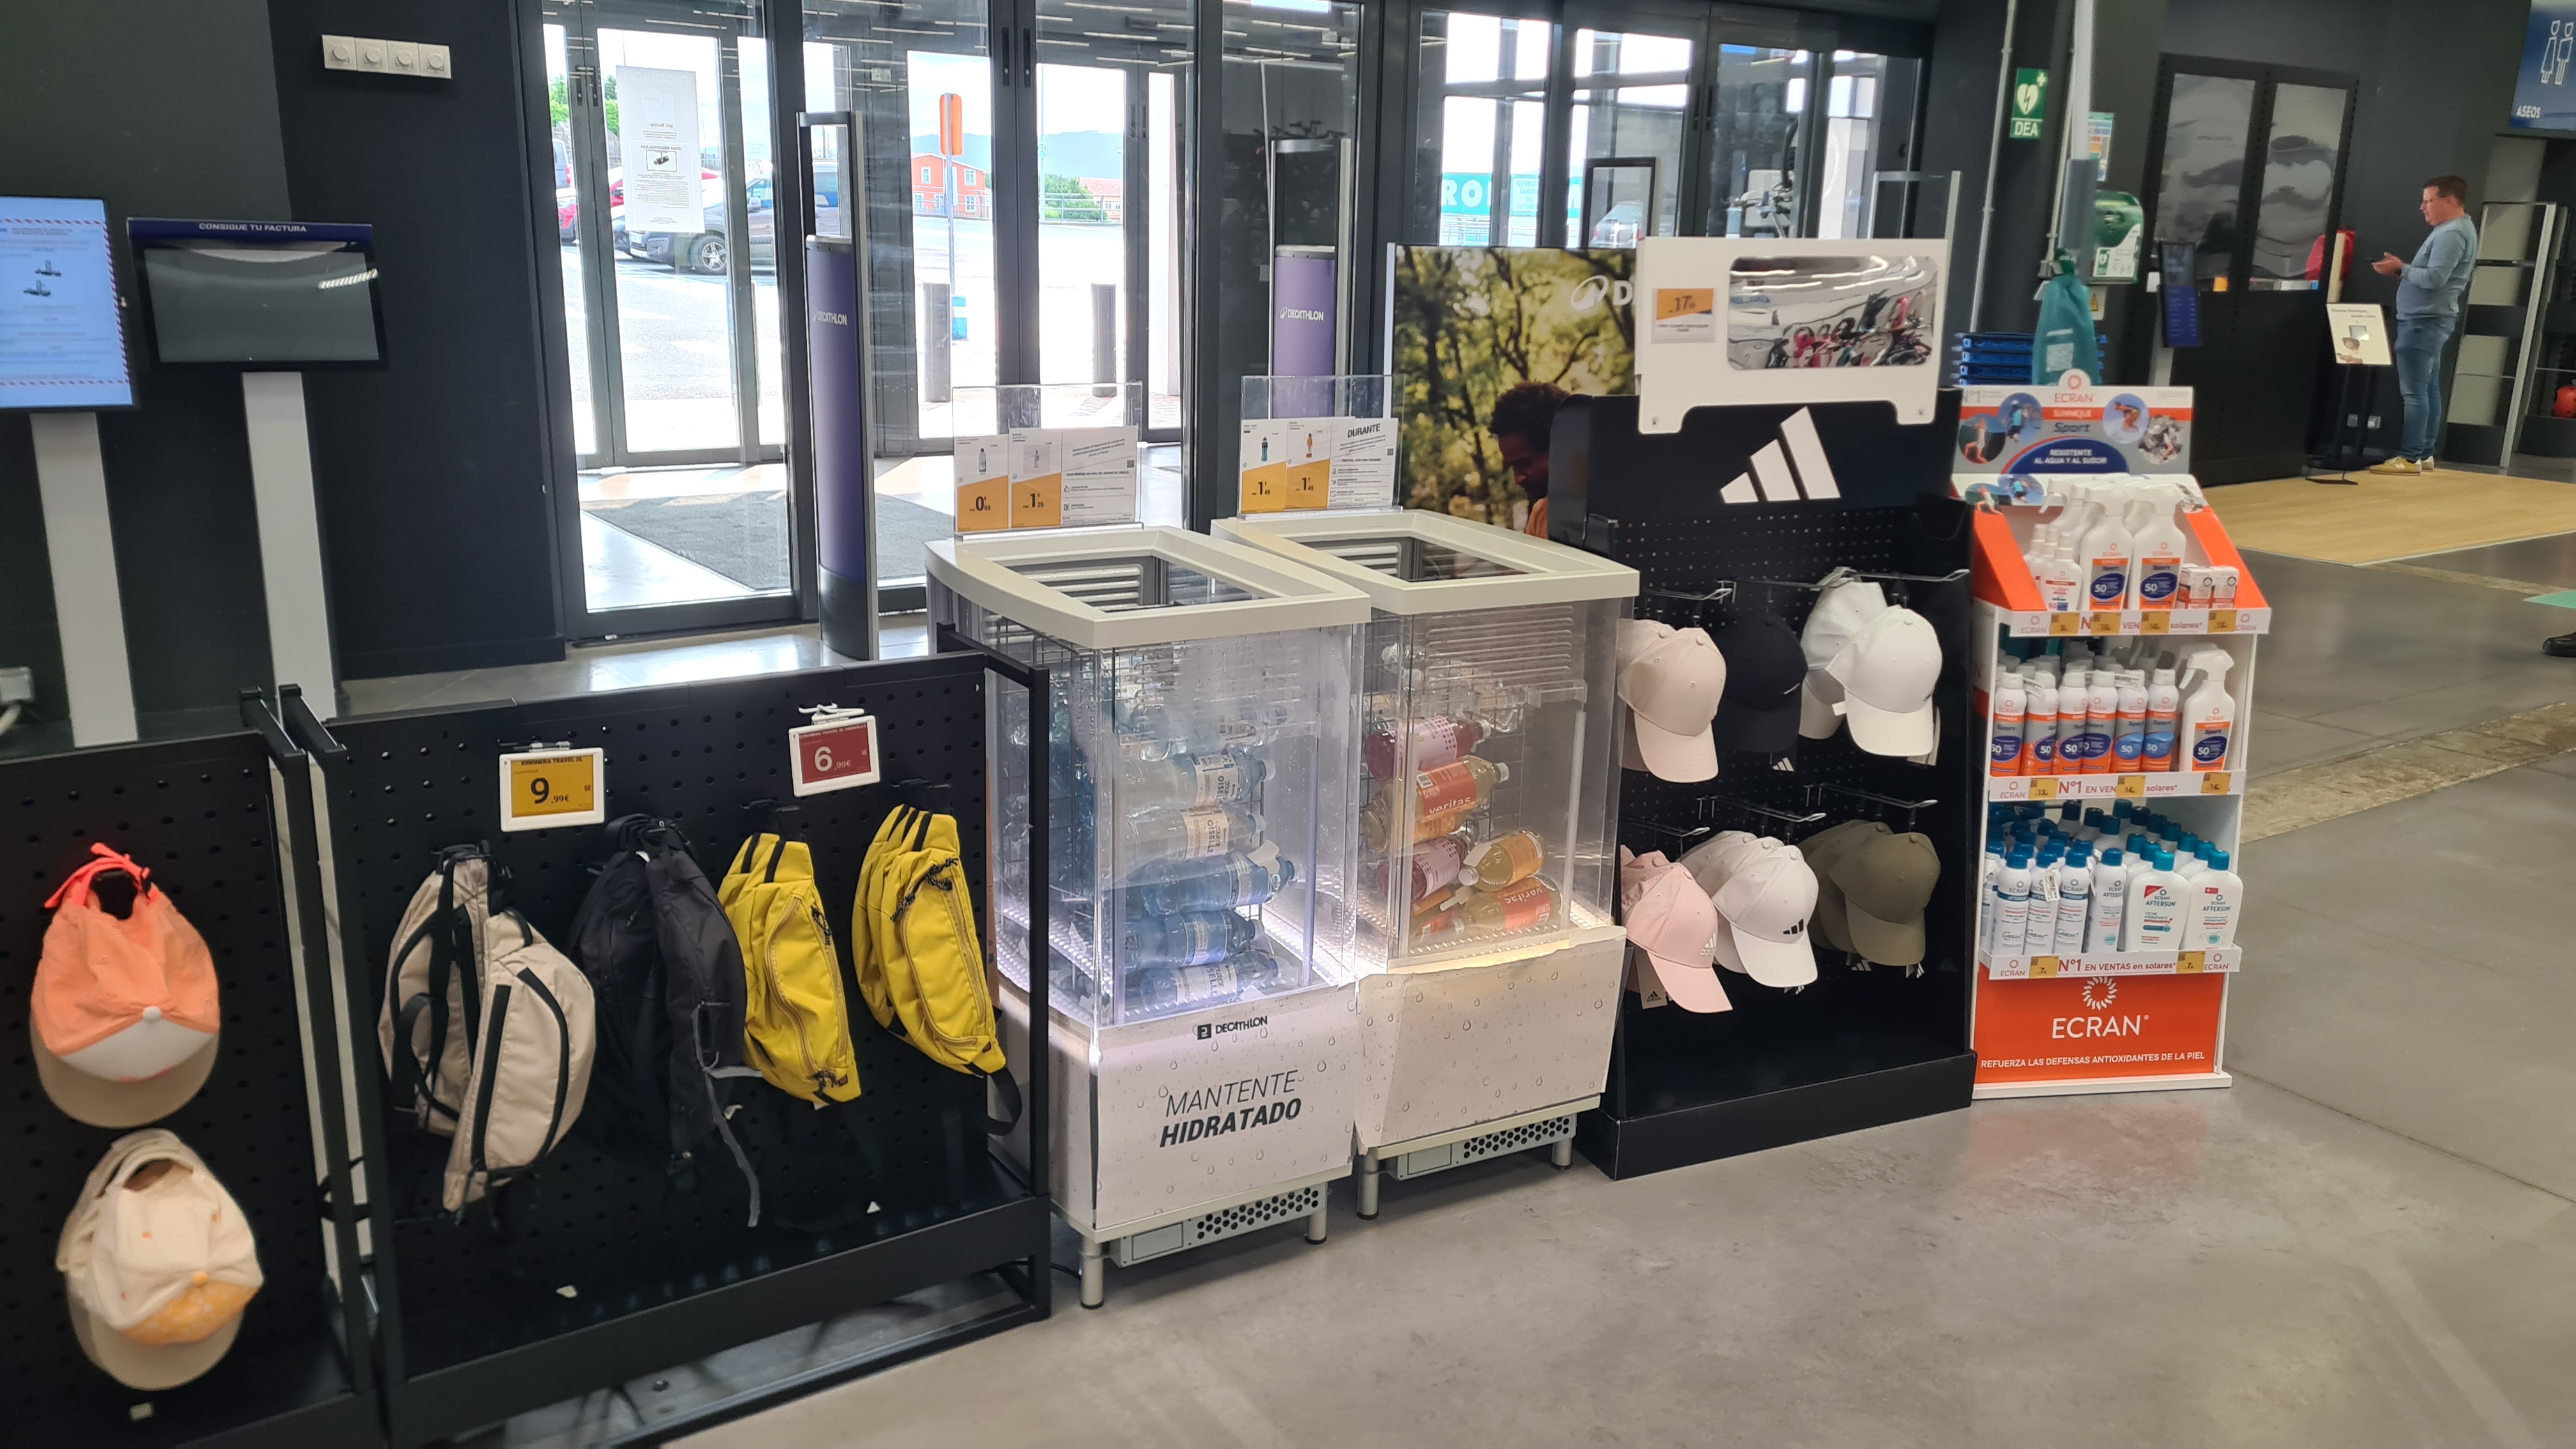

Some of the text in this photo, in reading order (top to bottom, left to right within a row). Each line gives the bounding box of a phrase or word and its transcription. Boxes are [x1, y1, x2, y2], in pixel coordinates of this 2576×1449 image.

[2516, 105, 2542, 119] ASEOS
[2014, 121, 2039, 137] DEA
[199, 222, 247, 231] CONSIGUE
[264, 224, 307, 233] FACTURA
[817, 310, 848, 326] DECATHLON
[1287, 309, 1324, 321] DECATHLON
[2055, 393, 2093, 403] ECRAN
[1347, 423, 1381, 438] DURANTE
[2053, 422, 2090, 433] Sport
[2094, 584, 2107, 593] 50
[2144, 583, 2158, 592] 50
[2040, 745, 2051, 754] 50
[2065, 744, 2078, 753] 50
[2146, 743, 2158, 751] 50
[2198, 746, 2209, 755] 50
[2058, 780, 2083, 794] N°1
[1429, 796, 1471, 815] veritas
[1206, 819, 1216, 854] OISELLE
[1504, 887, 1544, 904] veritas
[2058, 958, 2082, 972] N°1
[2099, 963, 2131, 971] VENTAS
[1215, 1015, 1268, 1034] DECATHLON
[1981, 1060, 2026, 1068] REFUERZA
[2028, 1058, 2044, 1066] LAS
[2046, 1056, 2090, 1066] DEFENSAS
[2092, 1053, 2159, 1064] ANTIOXIDANTES
[2186, 1051, 2205, 1060] PIEL
[1165, 1069, 1299, 1118] MANTENTE
[1159, 1098, 1302, 1148] HIDRATADO
